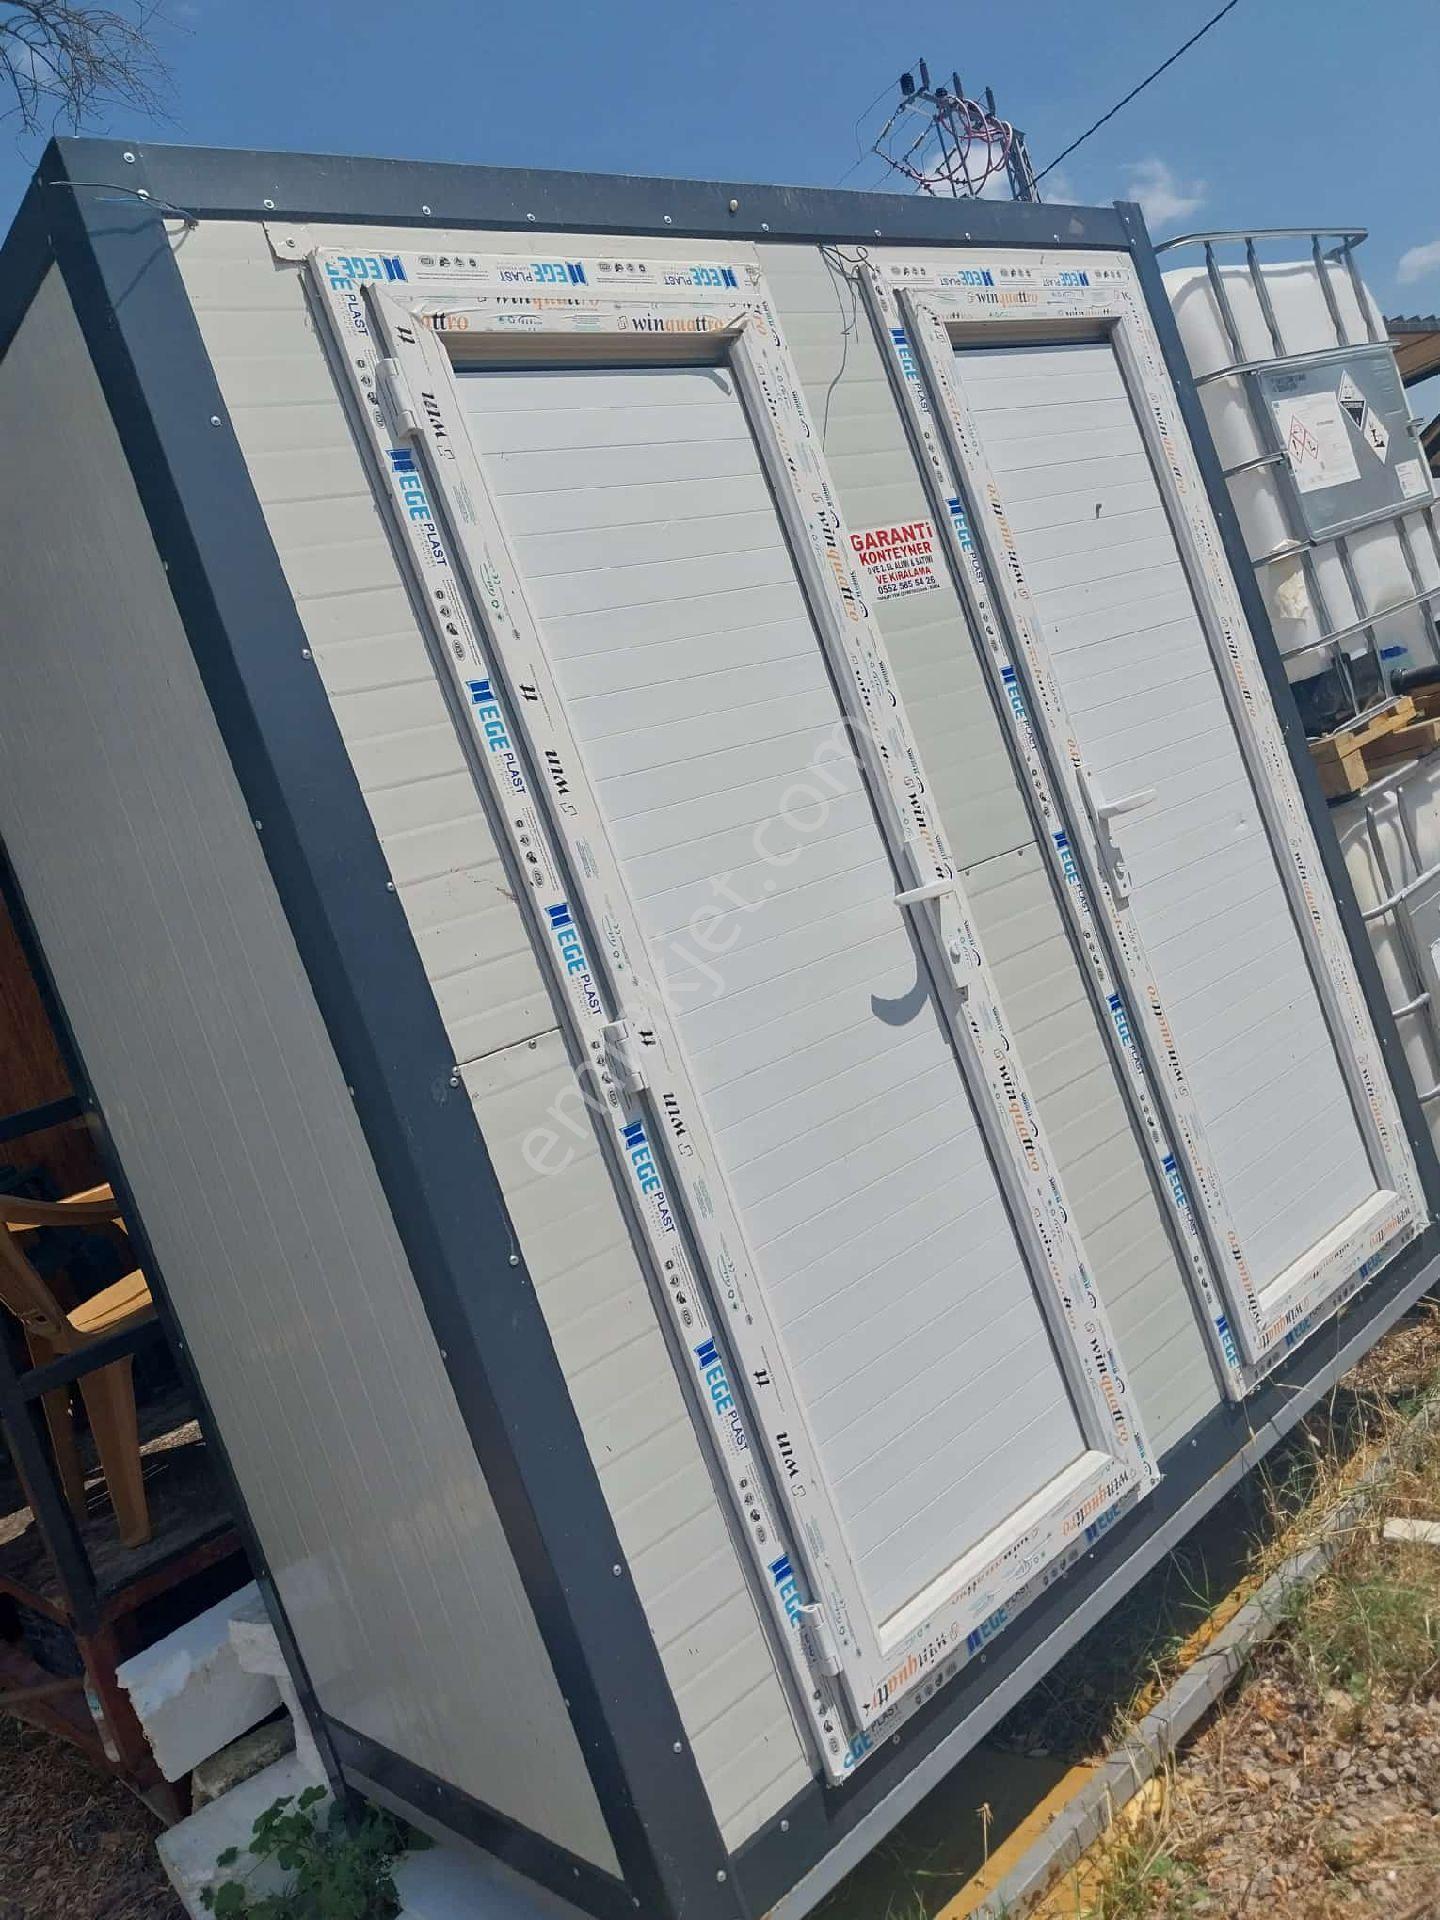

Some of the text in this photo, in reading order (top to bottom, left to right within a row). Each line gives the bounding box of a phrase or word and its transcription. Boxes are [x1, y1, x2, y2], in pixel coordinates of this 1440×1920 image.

[500, 262, 569, 283] EGE PLAST
[664, 266, 723, 287] EGE PLAST
[958, 270, 984, 287] EGE
[1058, 271, 1081, 287] EGE
[344, 294, 369, 336] PLAST
[897, 348, 932, 415] EGE PLAST
[398, 474, 447, 567] EGE PLAST
[858, 541, 933, 567] KONTEYNER
[954, 517, 985, 585] EGE PLAST
[875, 574, 889, 585] VE
[877, 583, 898, 595] 0552
[1007, 684, 1025, 720] EGE
[478, 705, 527, 795] EGE PLAST
[1061, 850, 1090, 914] EGE PLAST
[556, 928, 603, 1016] EGE PLAST
[1114, 1010, 1132, 1047] EGE
[631, 1146, 677, 1233] EGE PLAST
[1169, 1173, 1187, 1209] EGE
[705, 1366, 749, 1452] EGE PLAST
